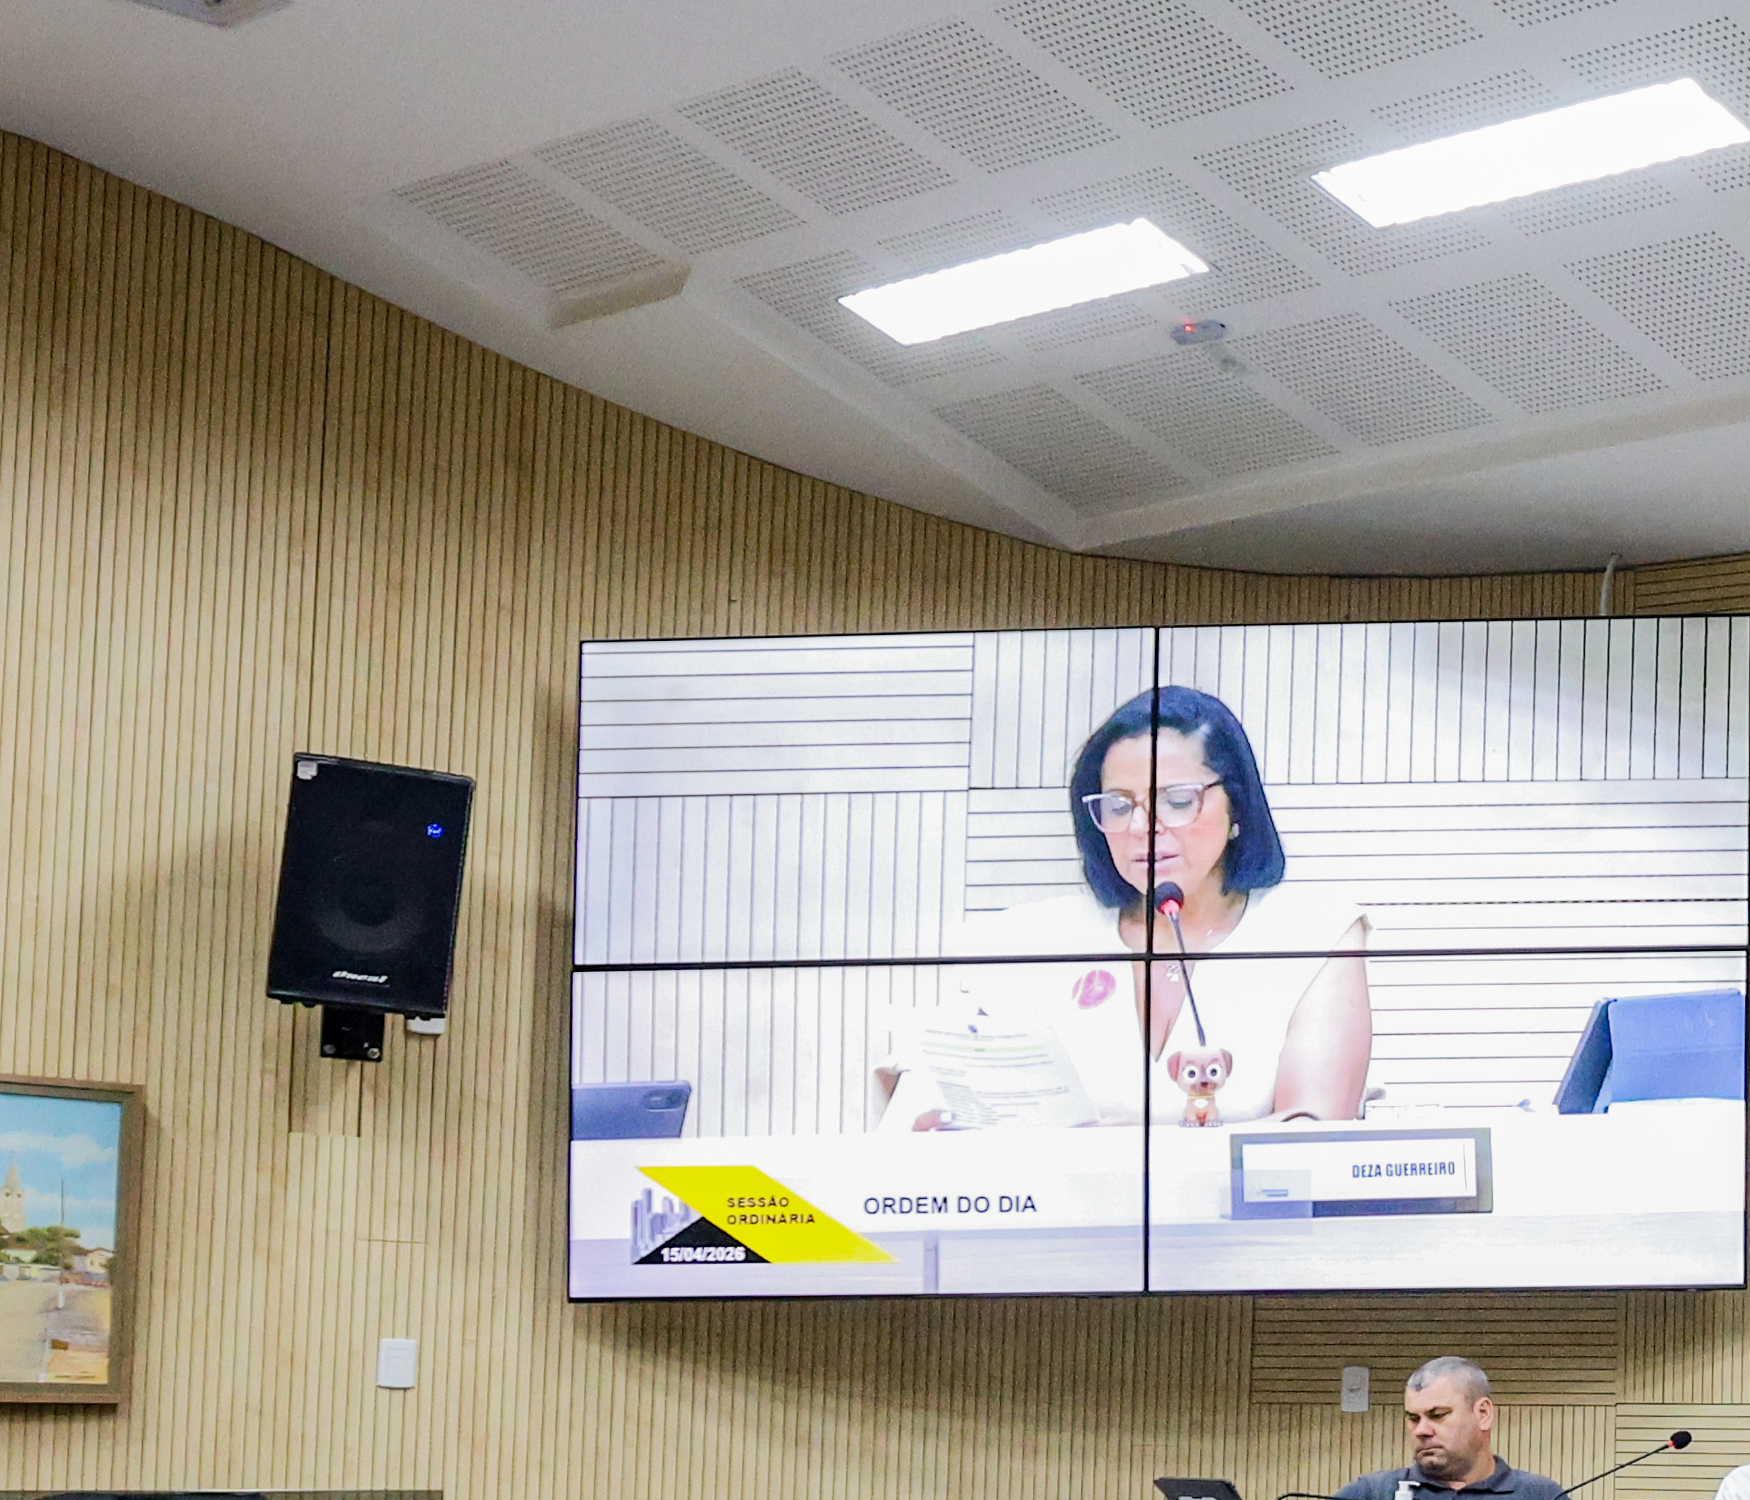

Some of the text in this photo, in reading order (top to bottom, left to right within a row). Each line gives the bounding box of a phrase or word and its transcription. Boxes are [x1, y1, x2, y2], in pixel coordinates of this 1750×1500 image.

[1352, 1161, 1455, 1178] DEZA GUERREIRO
[726, 1195, 790, 1208] SESSÃO
[863, 1195, 1037, 1215] ORDEM DO DIA
[726, 1211, 816, 1226] ORDINÁRIA
[660, 1246, 746, 1263] 15/04/2026
